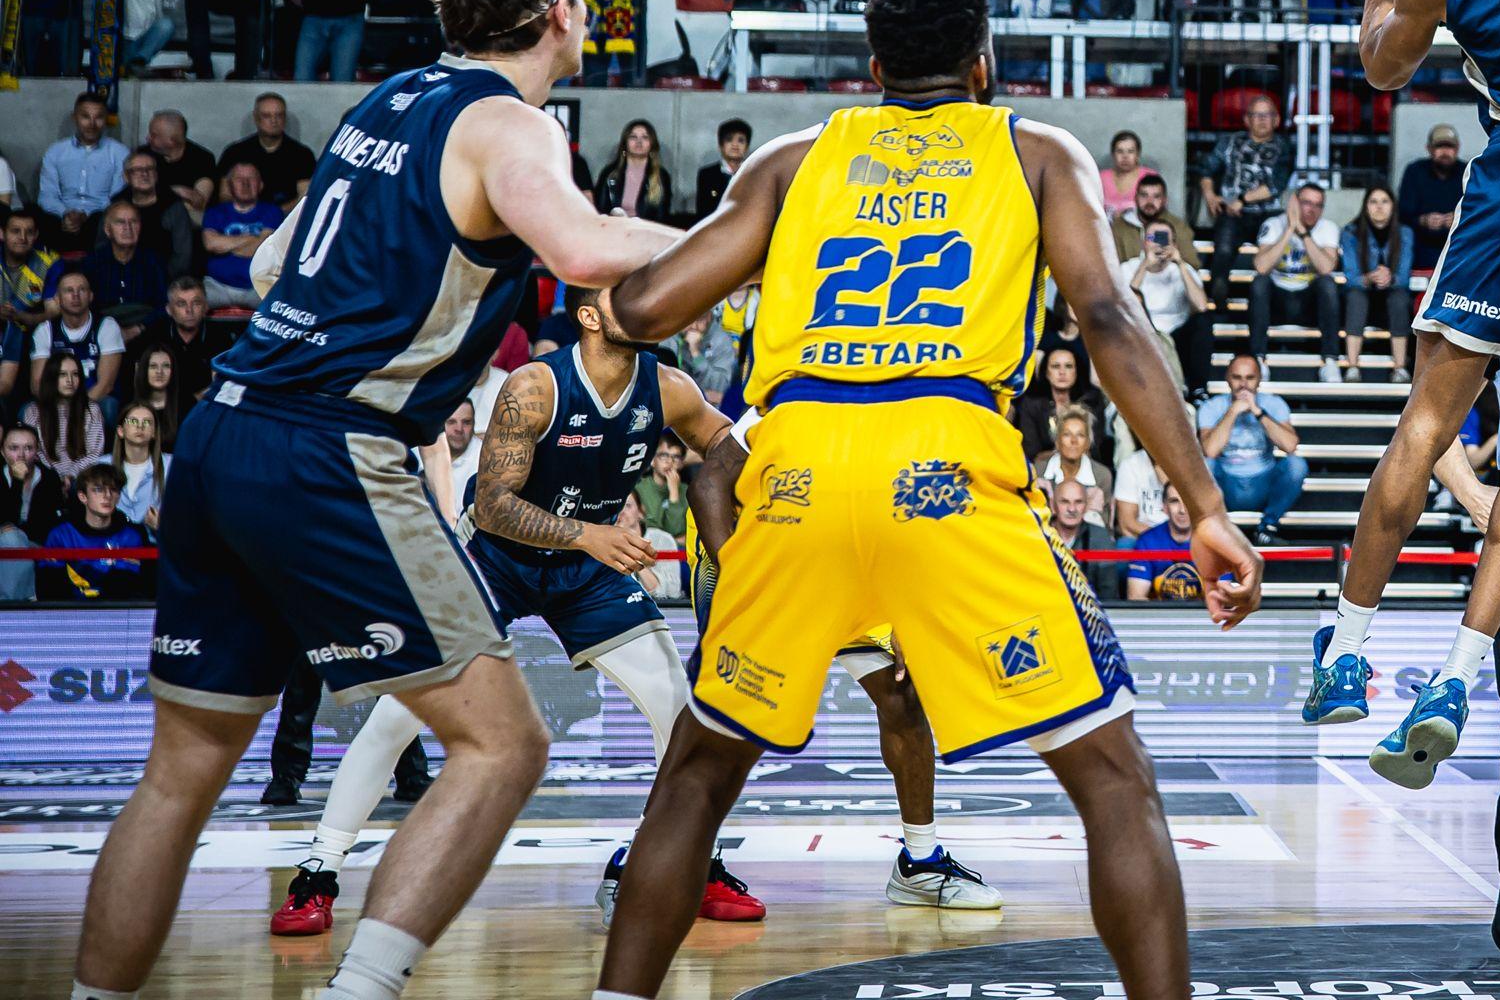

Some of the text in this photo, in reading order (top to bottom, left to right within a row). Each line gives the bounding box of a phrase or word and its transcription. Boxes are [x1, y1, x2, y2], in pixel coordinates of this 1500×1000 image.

[297, 177, 352, 279] 0
[804, 229, 973, 331] 22
[821, 342, 963, 366] BETARD
[621, 443, 649, 474] 2
[306, 642, 379, 666] netuno
